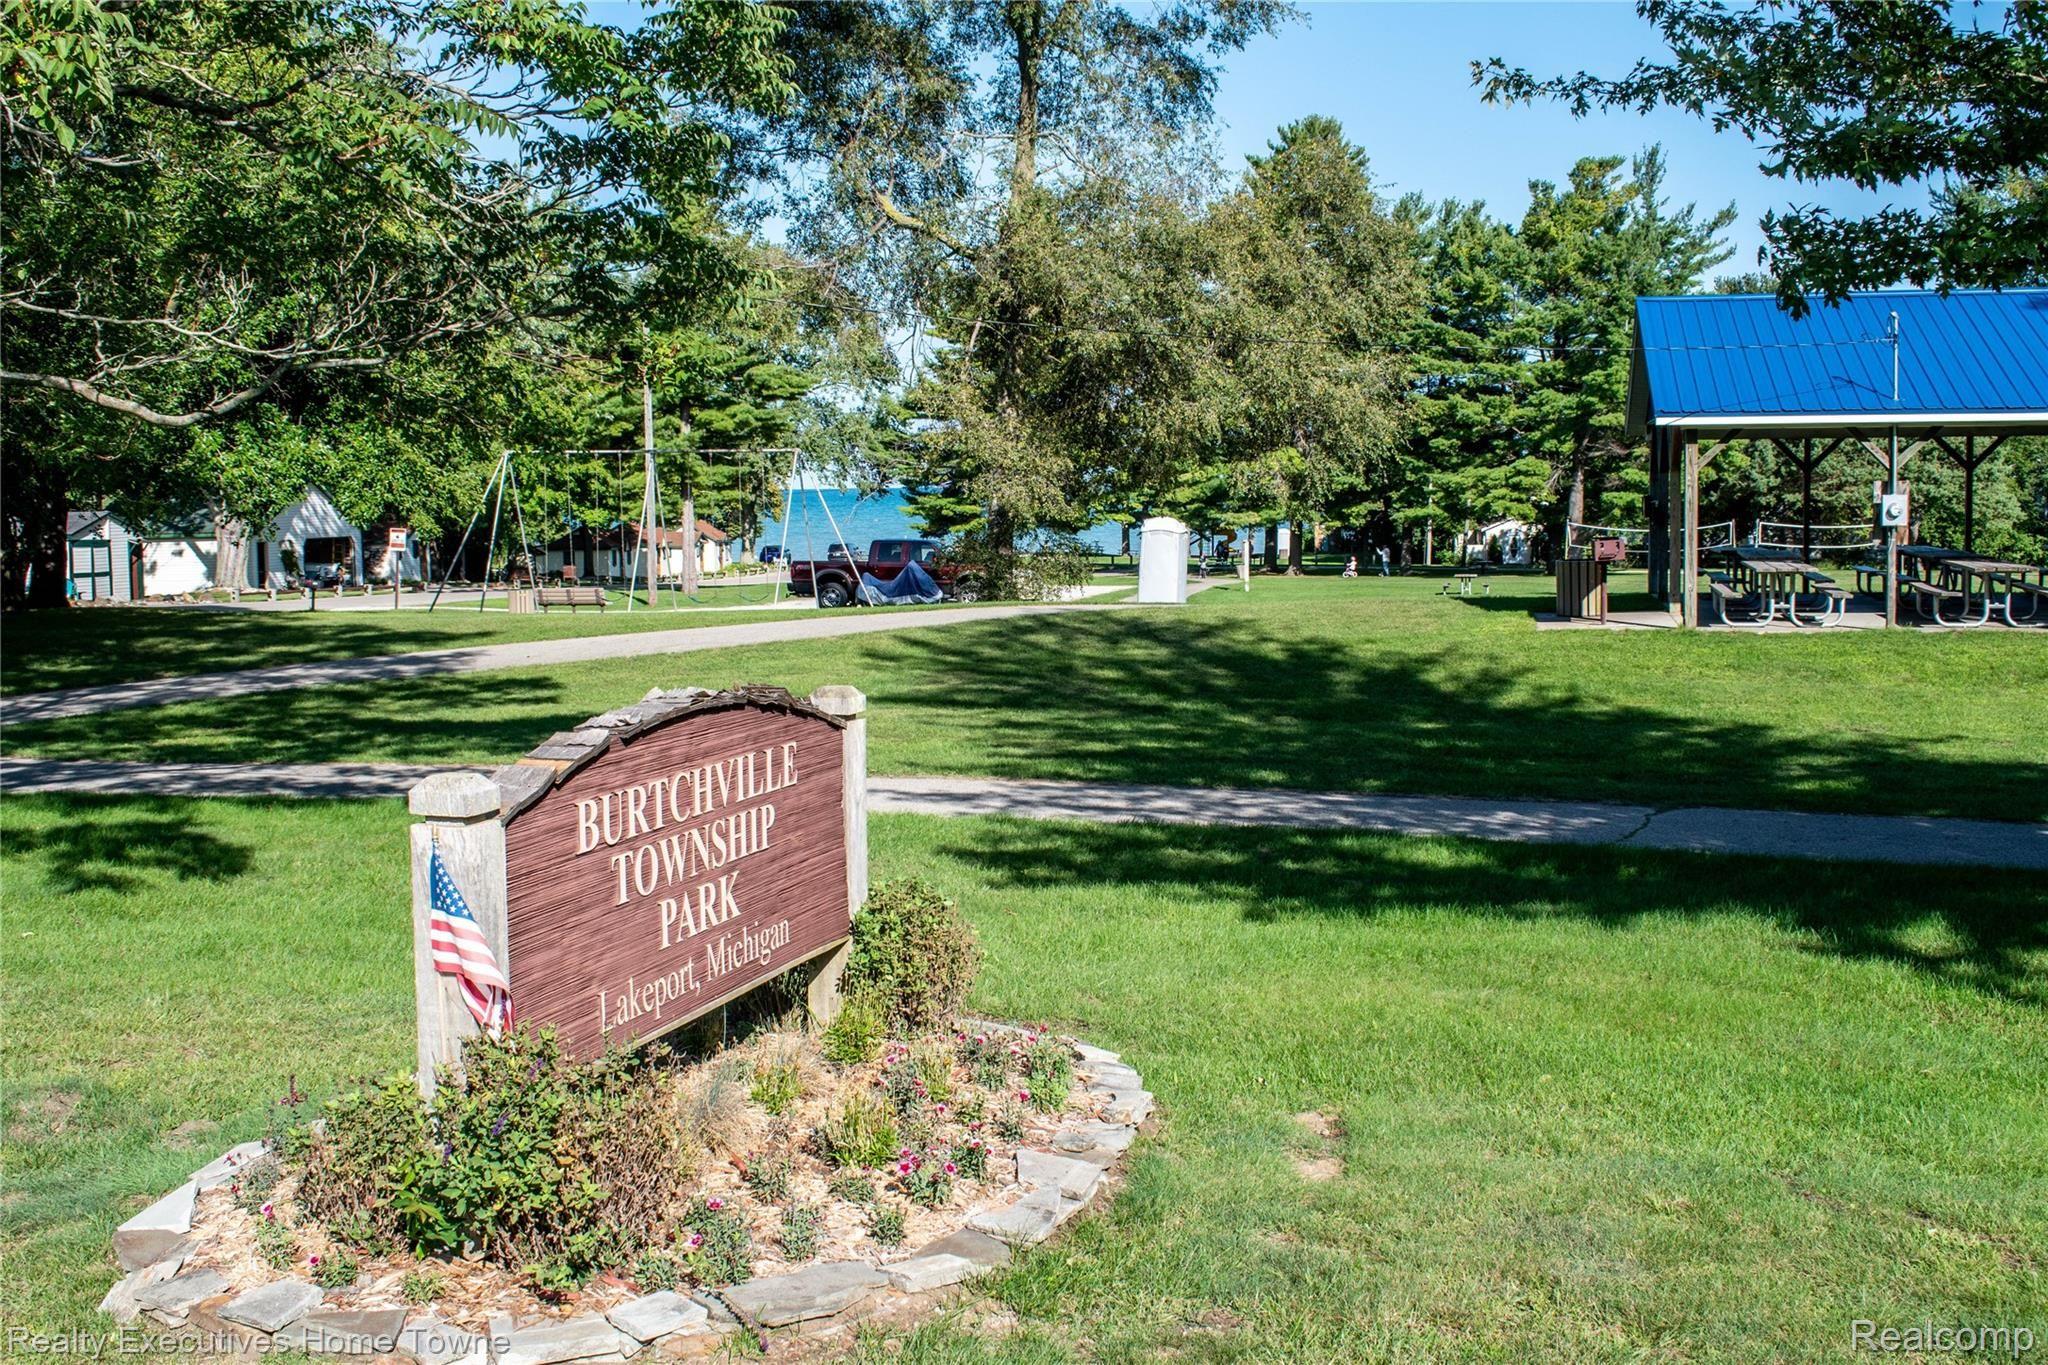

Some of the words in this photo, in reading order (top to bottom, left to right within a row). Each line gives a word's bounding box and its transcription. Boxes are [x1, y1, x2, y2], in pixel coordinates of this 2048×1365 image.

[575, 741, 798, 855] BURTCHVILLE
[611, 804, 776, 906] TOWNSHIP
[658, 870, 742, 950] PARK
[600, 959, 701, 1032] Lakeport,
[706, 919, 791, 982] Michigan
